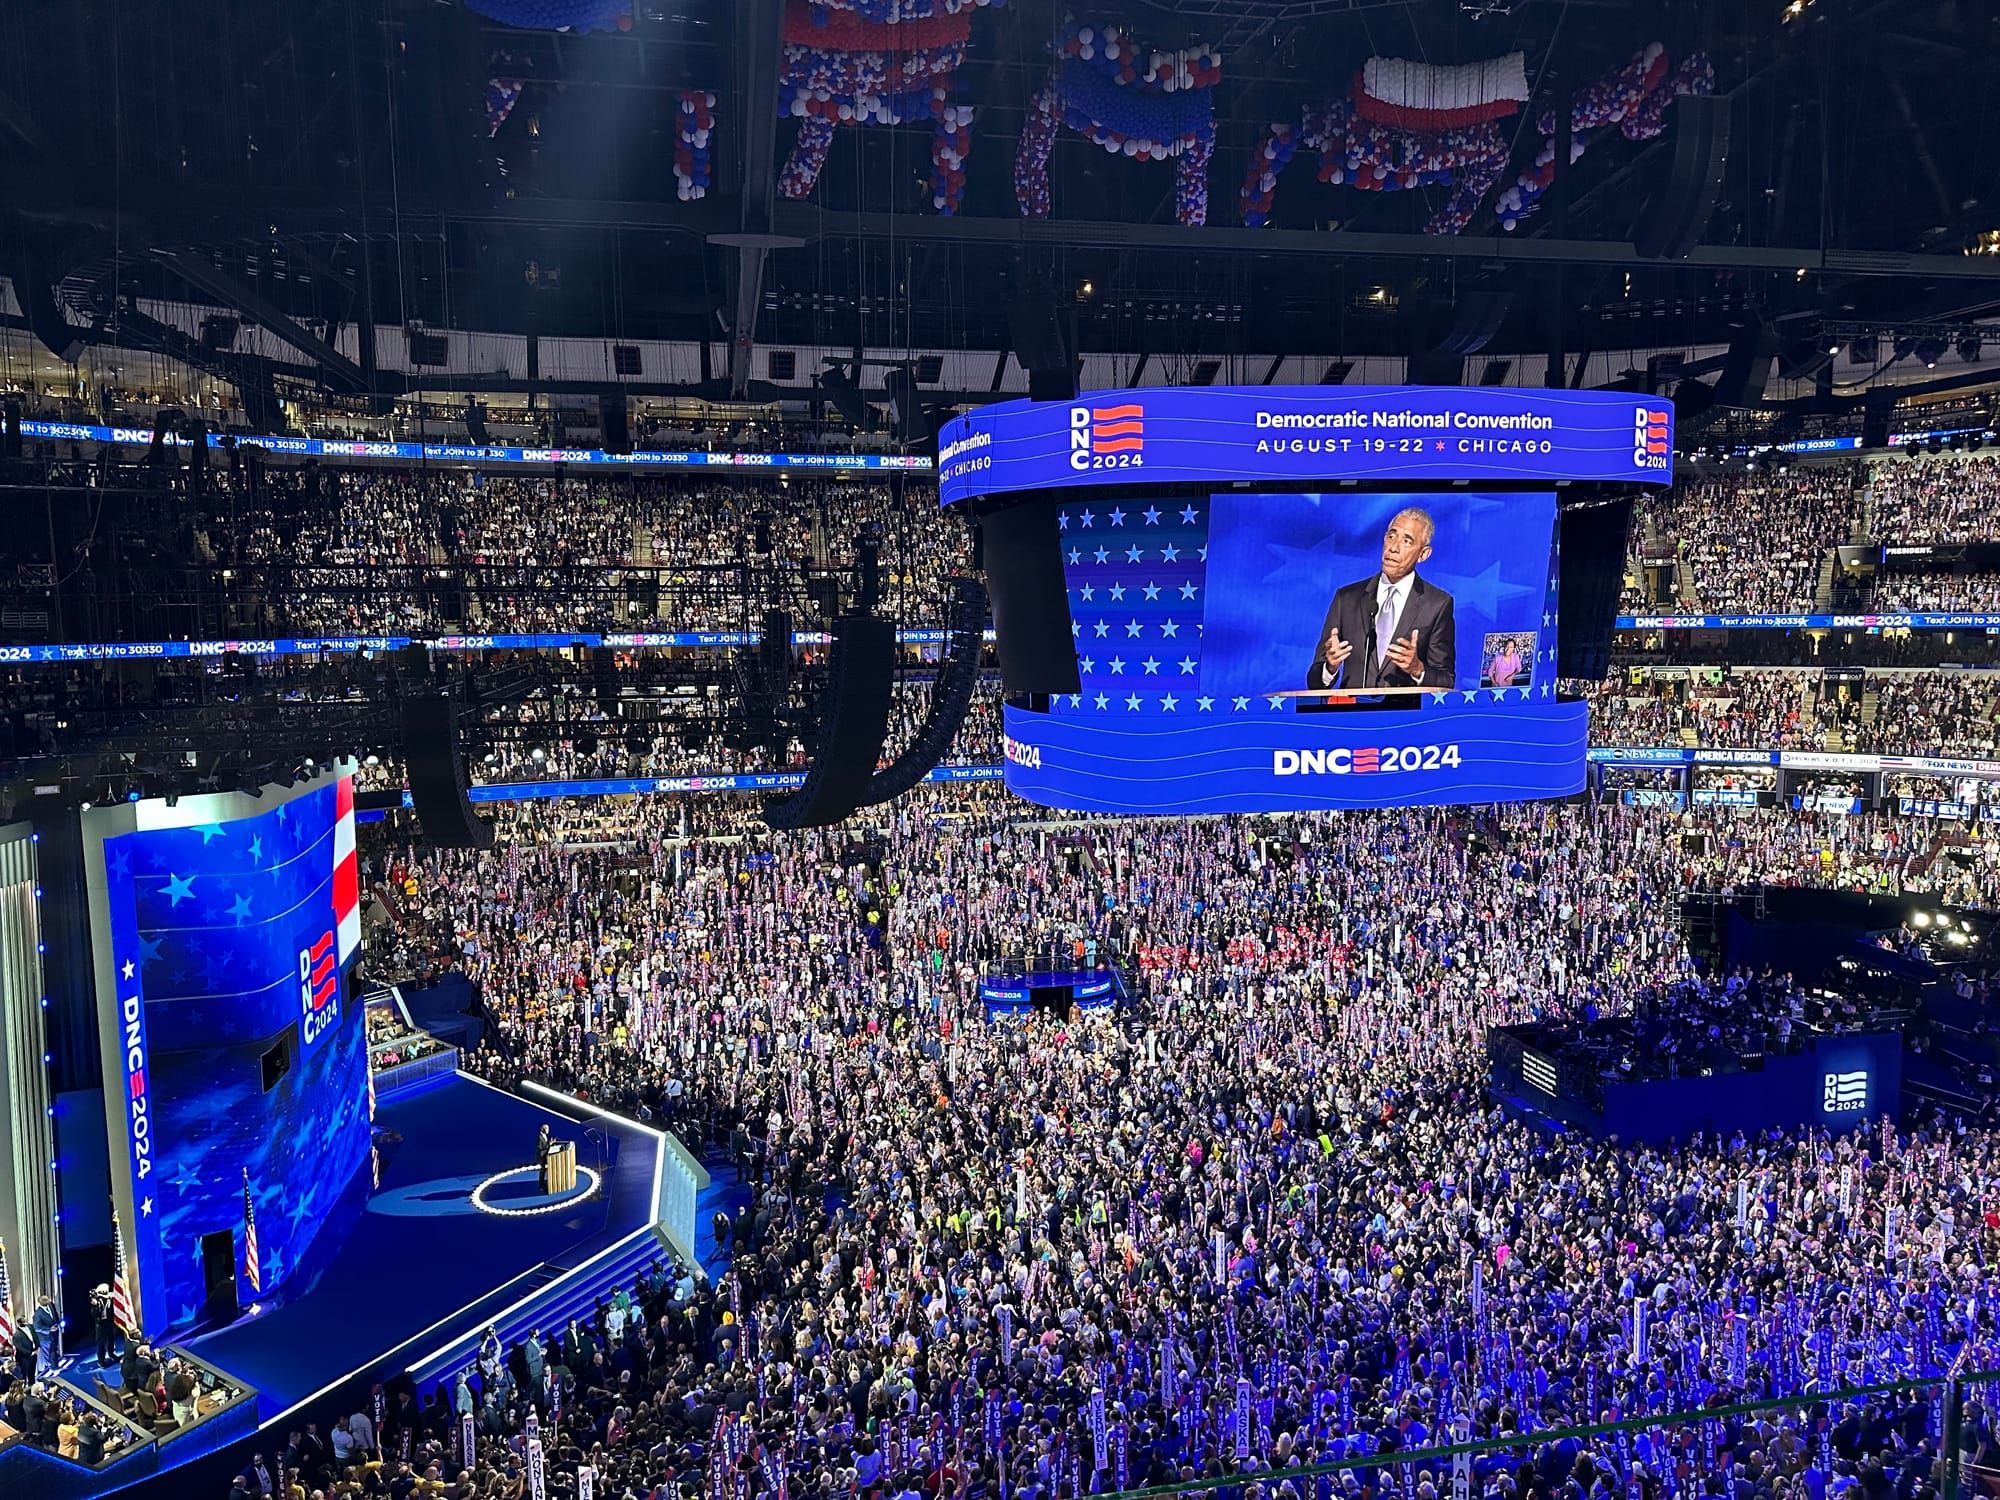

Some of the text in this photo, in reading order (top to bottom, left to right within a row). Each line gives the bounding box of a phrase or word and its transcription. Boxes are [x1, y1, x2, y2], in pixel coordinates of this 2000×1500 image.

[1256, 410, 1553, 429] Democratic National Convention
[276, 441, 308, 450] 30330
[365, 443, 399, 455] 2024
[1256, 438, 1552, 453] AUGUST 19-22 CHICAGO
[1807, 440, 1836, 450] 30330
[444, 448, 464, 457] JOIN
[562, 450, 592, 461] 2024
[662, 454, 688, 462] 30330
[743, 453, 772, 464] 2024
[806, 456, 825, 464] JOIN
[955, 456, 991, 477] CHICAGO
[1093, 454, 1143, 469] 2024
[1646, 455, 1667, 469] 2024
[1635, 617, 1705, 627] DNC 2024
[1720, 617, 1739, 625] Text
[1740, 617, 1763, 625] JOIN
[1833, 616, 1912, 626] DNC 2024
[1924, 616, 1945, 624] Text
[1947, 616, 1973, 625] JOIN
[459, 636, 494, 648] 2024
[644, 634, 676, 645] 2024
[698, 635, 717, 643] Text
[719, 635, 739, 643] JOIN
[128, 646, 163, 655] 30330
[239, 640, 276, 653] 2024
[1014, 740, 1041, 770] 2024
[1273, 744, 1461, 775] DNC 2024
[1624, 749, 1653, 759] NEWS
[1694, 750, 1771, 762] AMERICA DECIDES
[1927, 760, 1973, 770] FOX NEWS
[951, 770, 970, 778] Text
[971, 769, 992, 777] JOIN
[659, 777, 736, 790] DNC 2024
[756, 776, 800, 785] Text JOIN
[1003, 991, 1022, 999] 2024
[315, 999, 338, 1036] 2024
[124, 995, 151, 1180] DNC 2024
[1836, 1100, 1866, 1111] 2024
[1396, 1360, 1404, 1391] VOTE
[1439, 1389, 1448, 1420] VOTE
[993, 1401, 1001, 1438] VOTE
[1238, 1391, 1247, 1446] ALASKA
[1933, 1398, 1941, 1437] VOTE
[712, 1413, 722, 1441] VOTE
[796, 1414, 805, 1441] VOTE
[1094, 1401, 1104, 1460] VERMONT
[1117, 1437, 1125, 1472] VOTE
[1821, 1432, 1830, 1472] VOTE
[277, 1462, 285, 1491] VOTE
[713, 1464, 721, 1496] VOTE
[759, 1456, 778, 1491] VOTE
